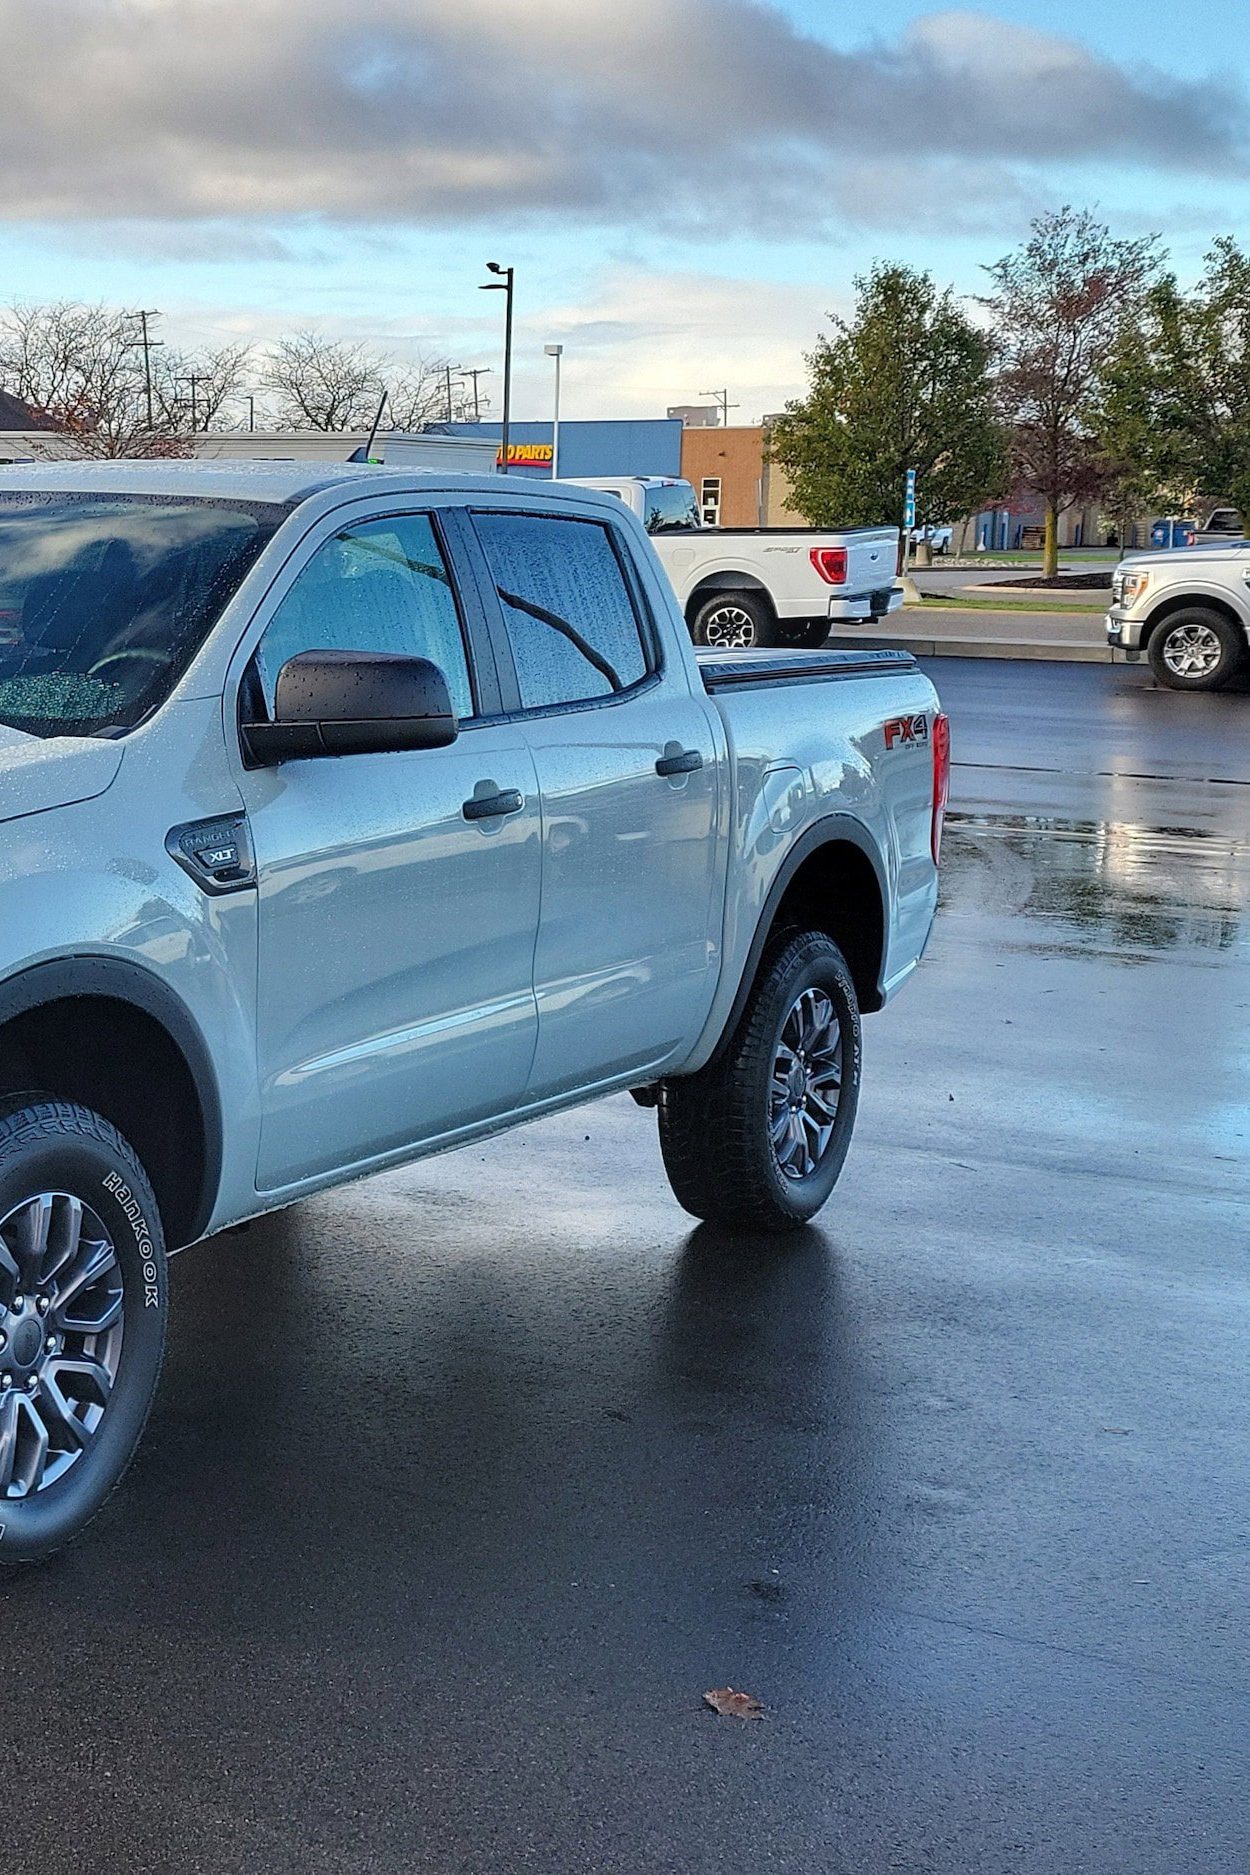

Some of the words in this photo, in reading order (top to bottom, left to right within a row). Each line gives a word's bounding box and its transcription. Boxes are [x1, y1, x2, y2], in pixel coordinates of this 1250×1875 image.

[516, 444, 553, 460] PARTS
[884, 714, 928, 750] FX4
[210, 848, 234, 862] XLT
